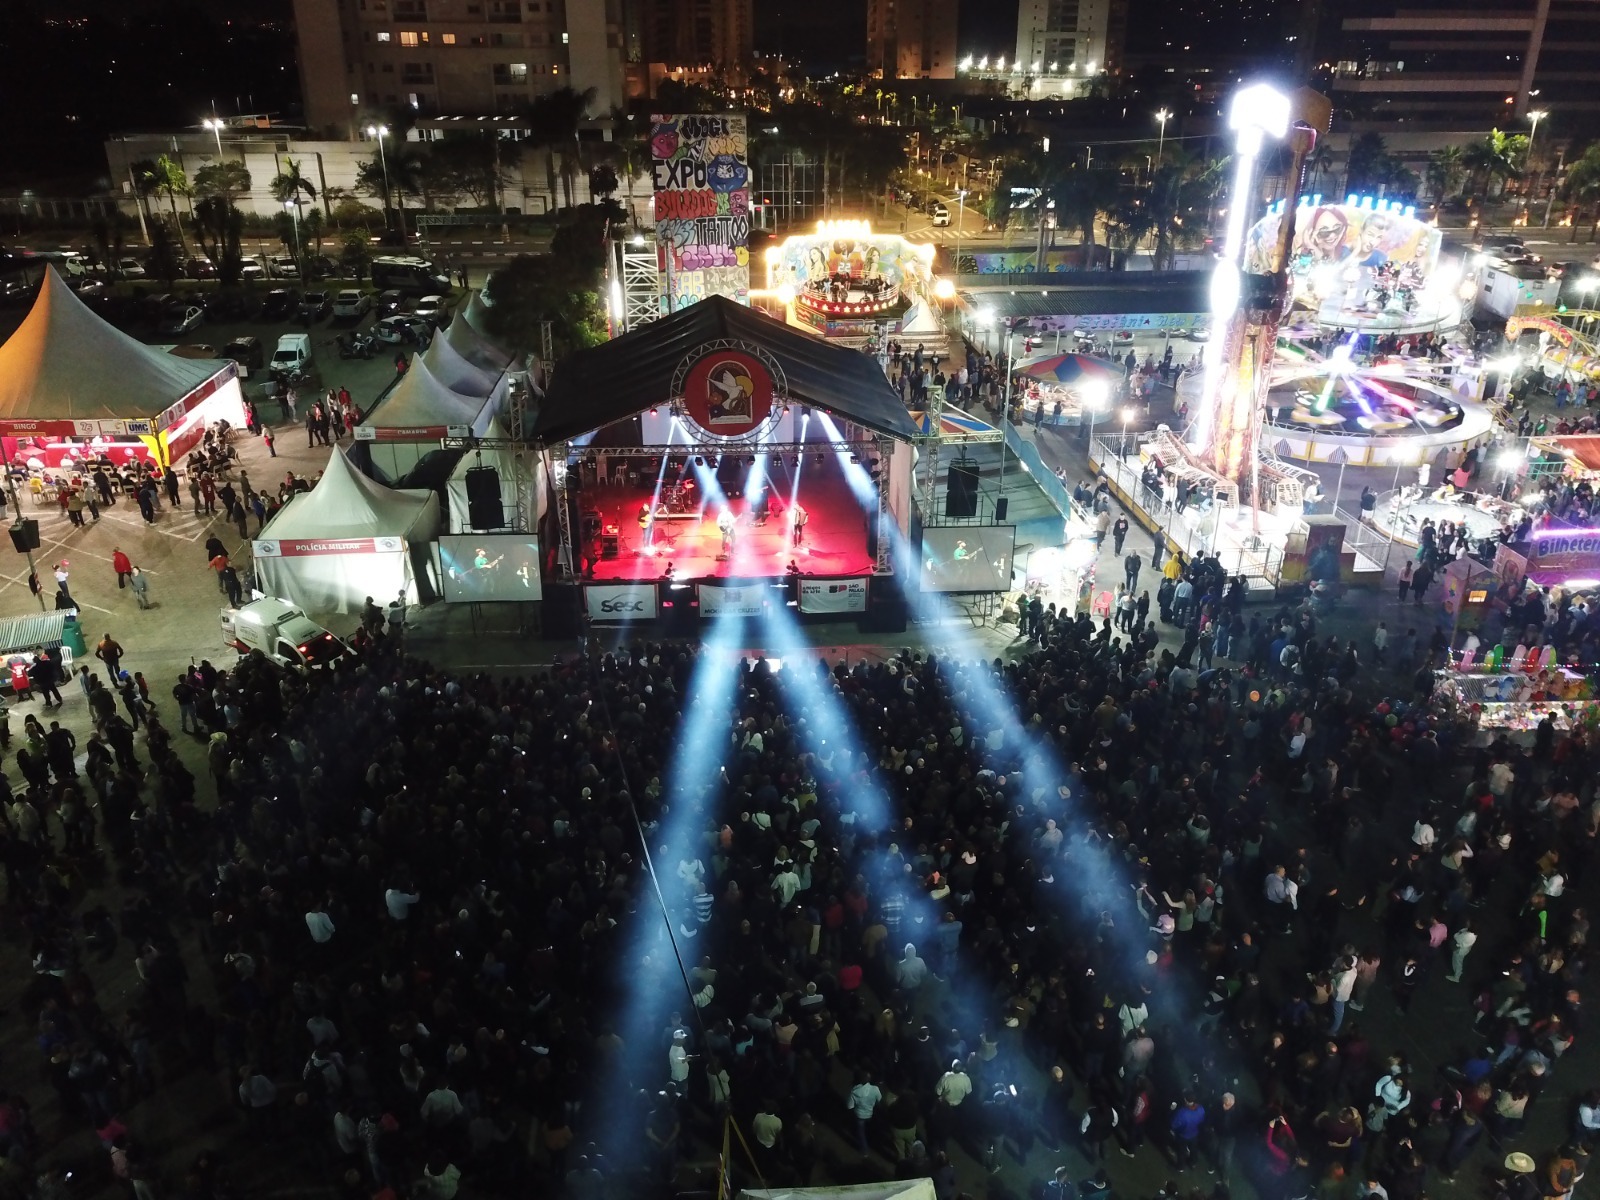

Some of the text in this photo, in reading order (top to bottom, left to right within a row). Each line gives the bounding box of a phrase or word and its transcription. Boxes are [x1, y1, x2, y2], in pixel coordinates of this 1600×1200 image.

[681, 114, 730, 139] MOGI
[653, 158, 707, 189] EXPO
[655, 189, 718, 219] BULLDOG
[695, 214, 749, 247] TATTOO
[128, 422, 149, 432] UMC
[295, 542, 361, 551] POLÍCIA MILITAR
